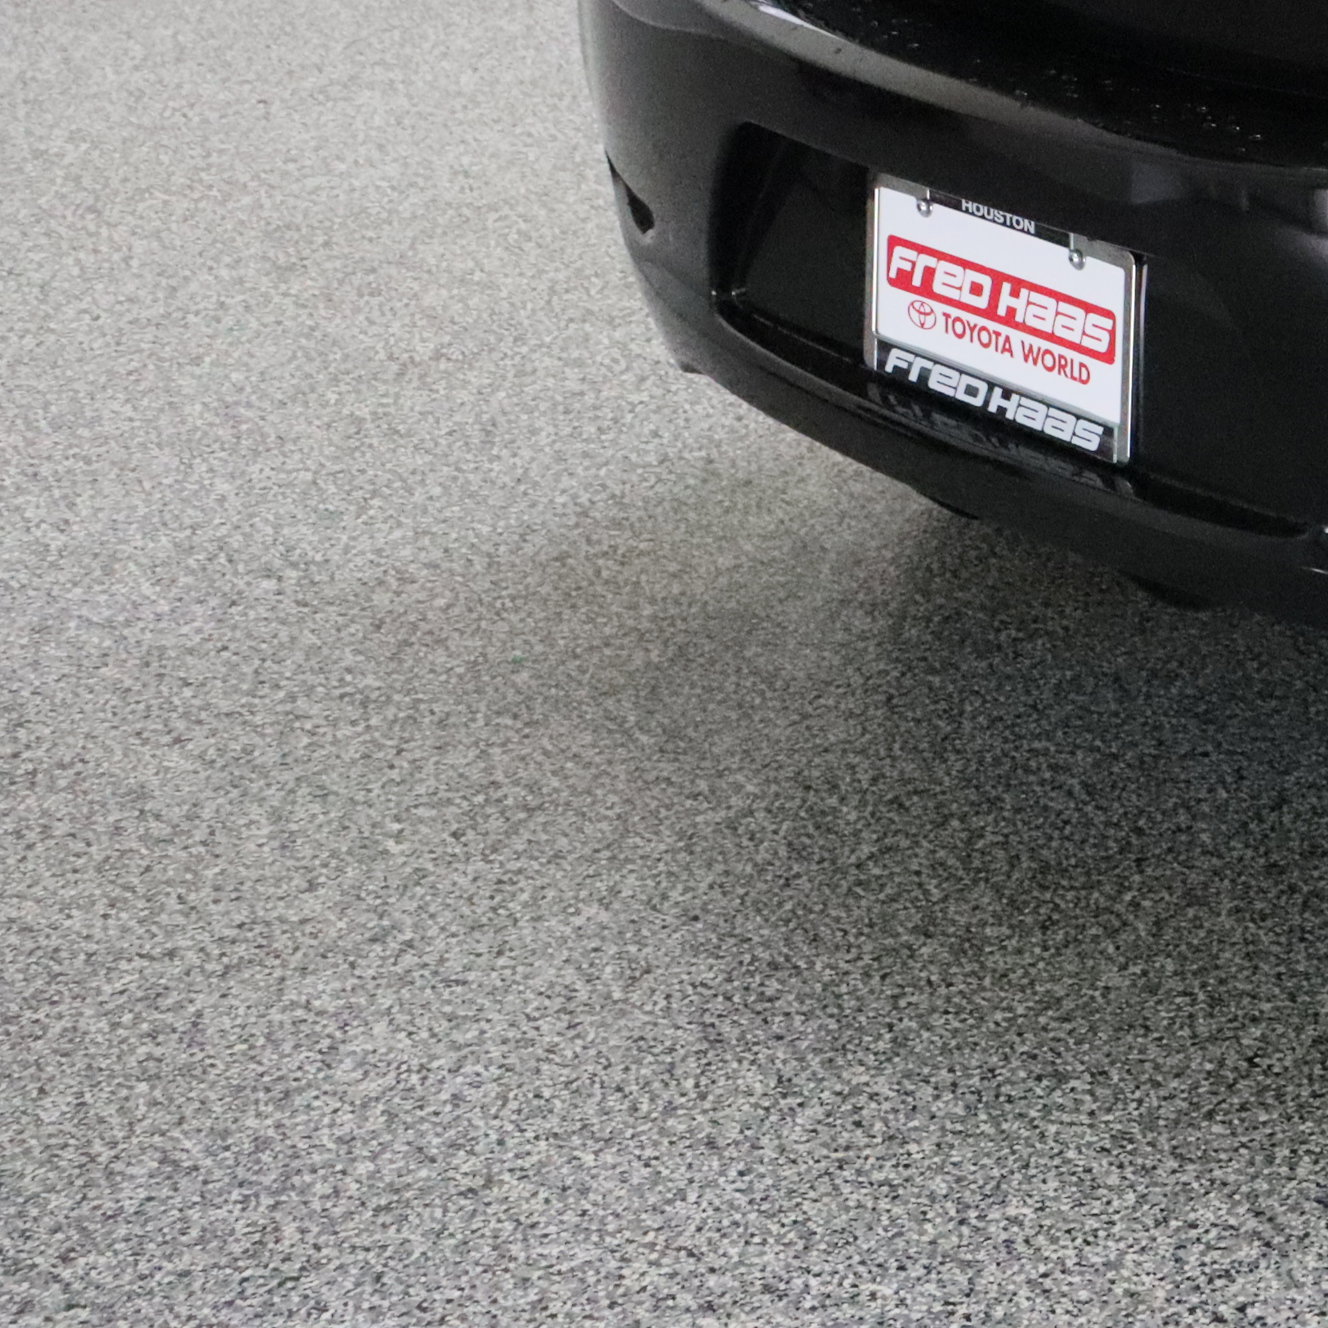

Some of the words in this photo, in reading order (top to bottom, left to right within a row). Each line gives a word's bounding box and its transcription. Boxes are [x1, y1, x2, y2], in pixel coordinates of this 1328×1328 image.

[961, 198, 1036, 235] HOUSTON
[942, 311, 1015, 359] TOYOTA
[1020, 339, 1092, 386] WORLD
